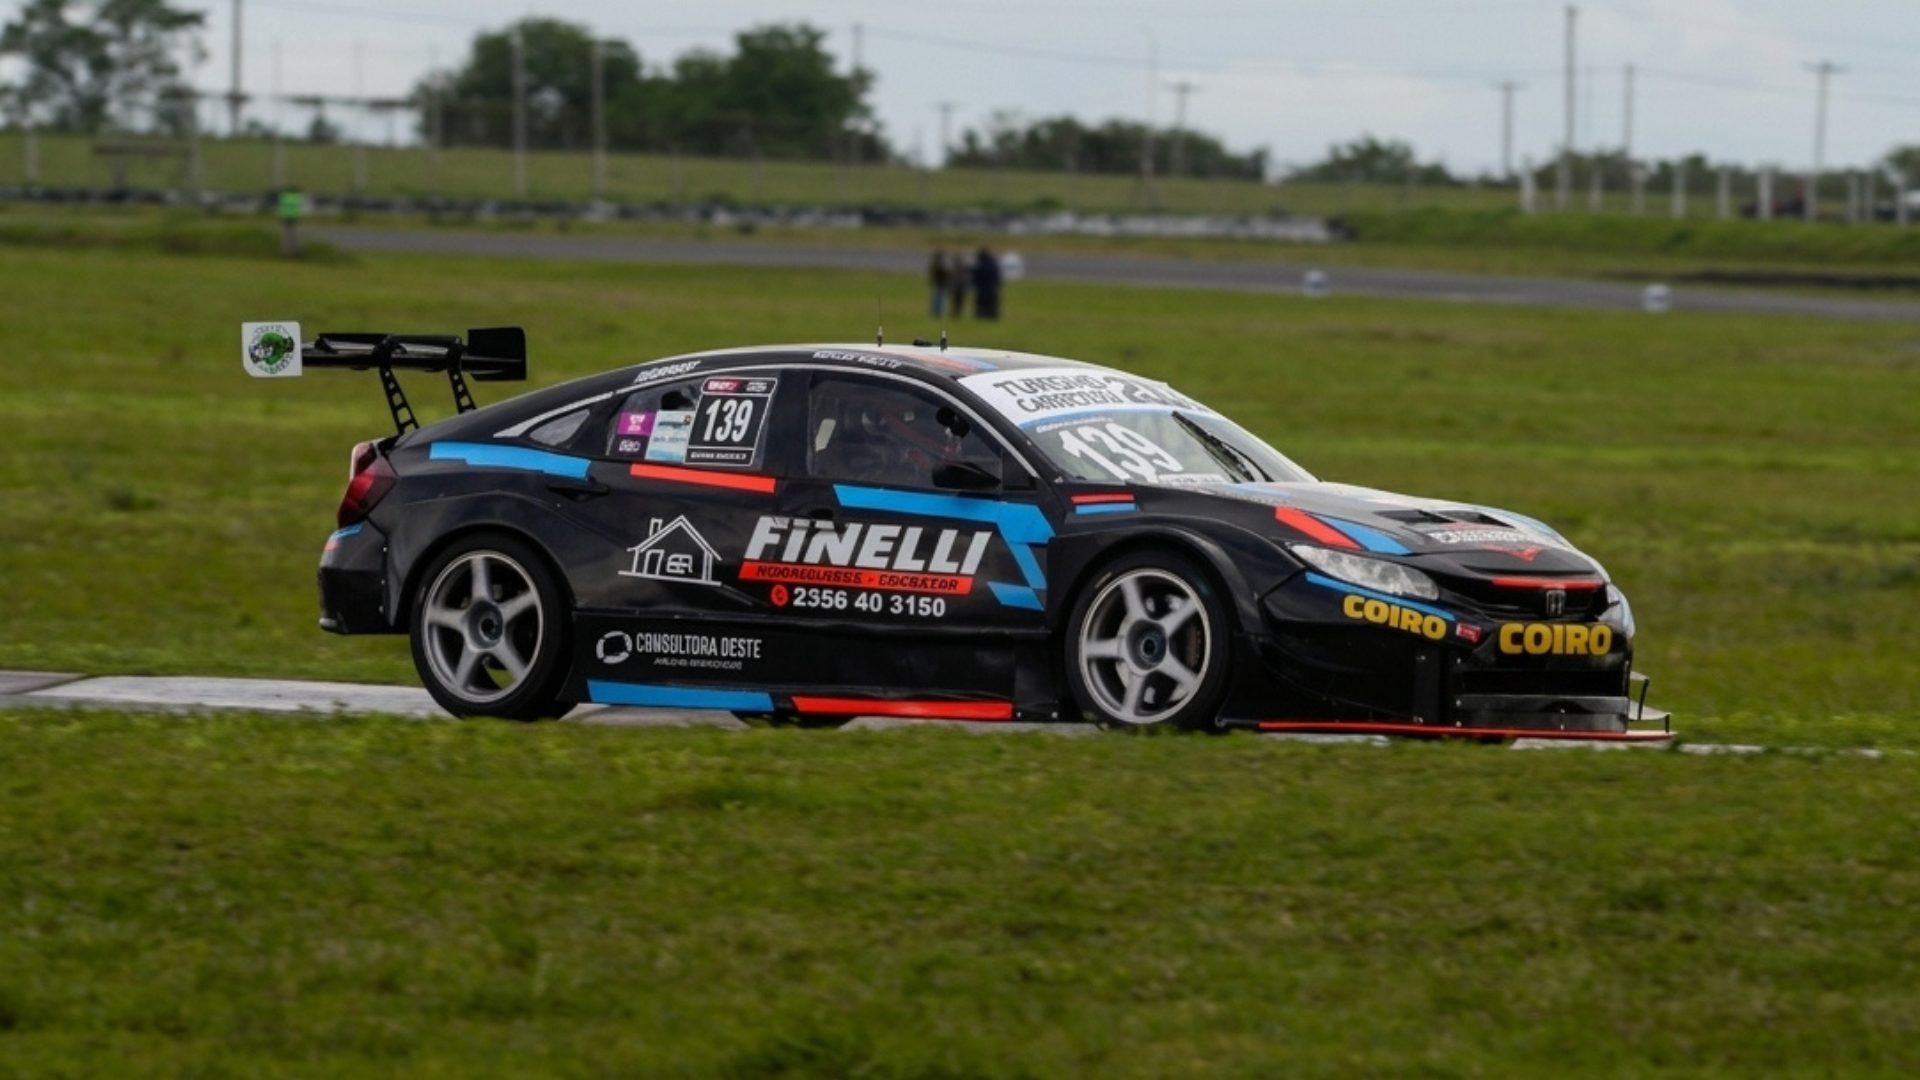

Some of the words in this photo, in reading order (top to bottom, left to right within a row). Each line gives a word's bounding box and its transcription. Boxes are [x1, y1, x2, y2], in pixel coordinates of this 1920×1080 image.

[703, 398, 754, 443] 139
[1058, 422, 1184, 484] 139
[743, 515, 993, 575] FINELLI
[854, 591, 883, 613] 40
[889, 594, 946, 618] 3150
[1343, 594, 1447, 639] COIRO
[1499, 622, 1613, 655] COIRO
